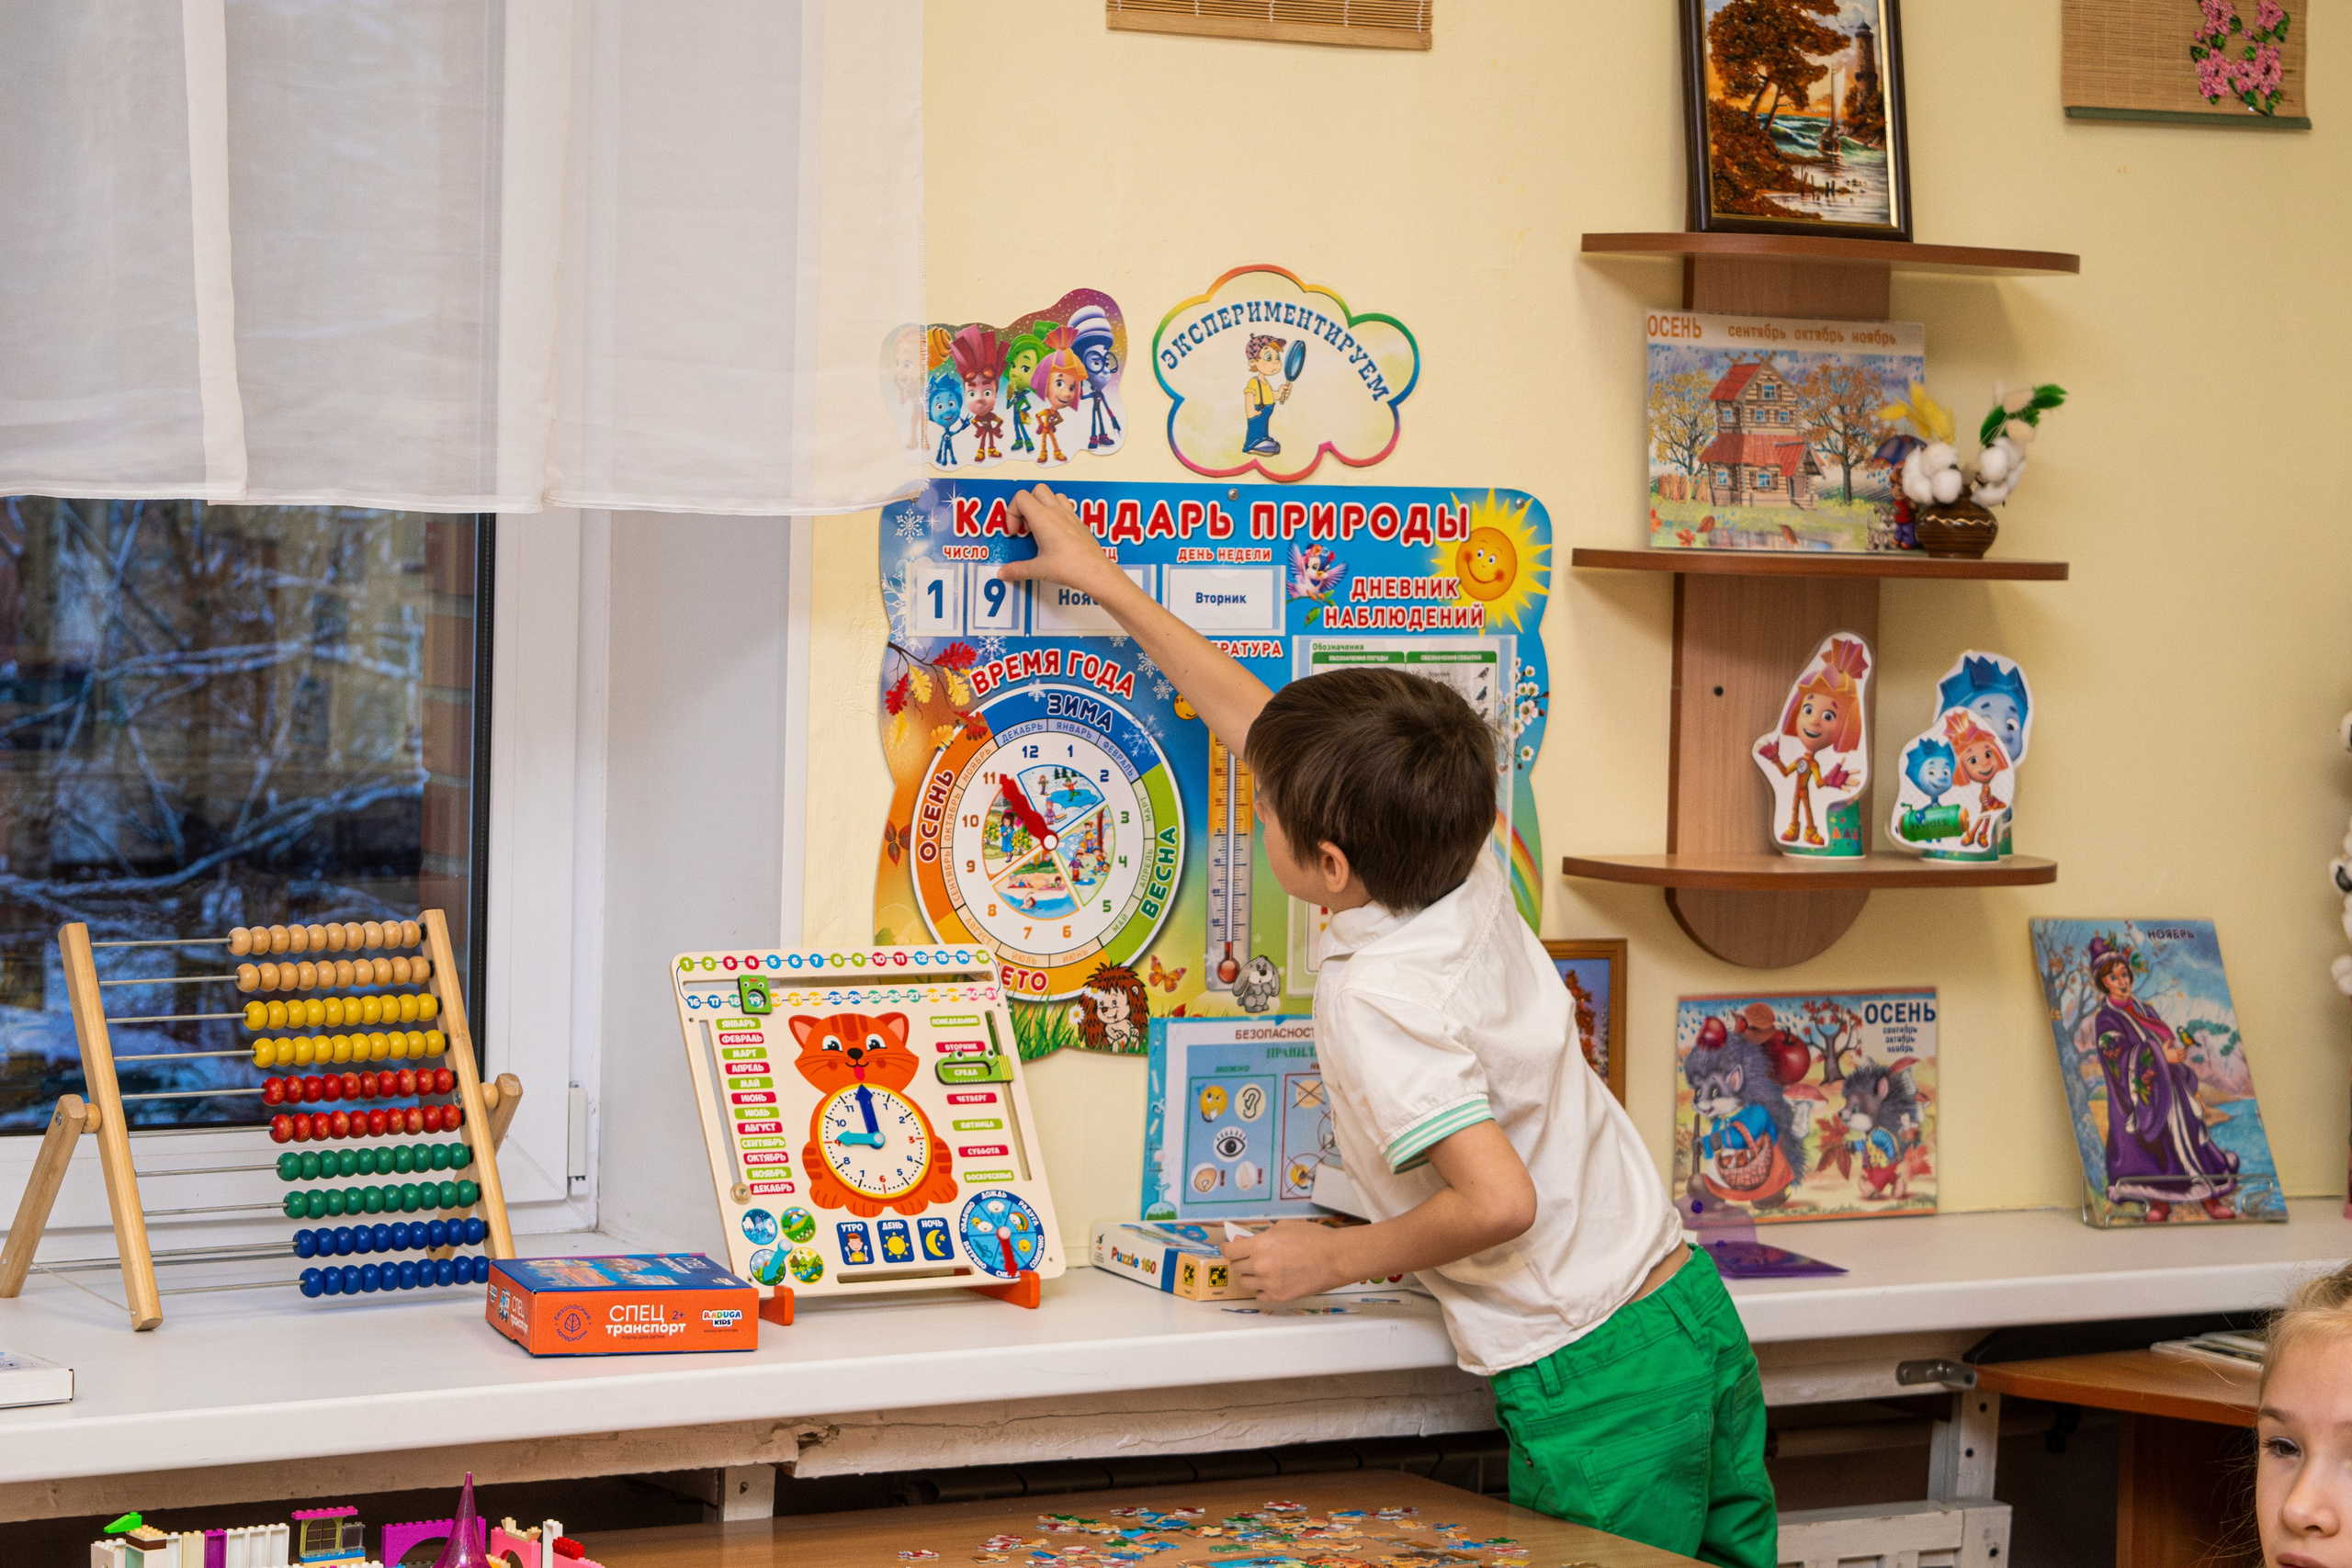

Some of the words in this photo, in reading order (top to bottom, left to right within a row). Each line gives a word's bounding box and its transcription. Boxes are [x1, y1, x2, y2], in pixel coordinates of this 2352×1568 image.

[1647, 314, 1702, 338] ОСЕНЬ
[1728, 323, 1786, 343] сентябрь
[1794, 326, 1844, 344] октябрь
[1851, 329, 1897, 347] ноябрь
[1160, 300, 1389, 401] ЭКСПЕРИМЕНТИРУЕМ
[954, 497, 1233, 545] КАНДАРЬ
[1251, 502, 1470, 547] ПРИРОДЫ
[944, 546, 989, 560] ЧИСЛО
[1178, 547, 1214, 563] ДЕНЬ
[1217, 548, 1272, 563] НЕДЕЛИ
[1351, 578, 1459, 602] ДНЕВНИК
[927, 580, 944, 618] 1
[984, 578, 1006, 618] 9
[1195, 592, 1247, 605] Вторник
[1324, 604, 1485, 631] НАБЛЮДЕНИЙ
[1312, 643, 1364, 651] Обозначения
[971, 649, 1059, 696] ВРЕМЯ
[1068, 649, 1136, 700] ГОДА
[1047, 694, 1114, 732] ЗИМА
[1001, 722, 1043, 743] ДЕКАБРЬ
[1057, 722, 1091, 739] ЯНВАРЬ
[1022, 745, 1039, 758] 12
[1067, 744, 1073, 758] 1
[962, 747, 991, 782] НОЯБРЬ
[1102, 740, 1134, 777] ФЕВРАЛЬ
[983, 772, 995, 784] 11
[1100, 769, 1109, 782] 2
[1139, 795, 1151, 822] МАРТ
[919, 769, 955, 862] ОСЕНЬ
[944, 793, 960, 840] ОКТЯБРЬ
[962, 815, 979, 828] 10
[1121, 810, 1129, 824] 3
[967, 860, 975, 873] 9
[1118, 855, 1127, 868] 4
[1139, 848, 1153, 888] АПРЕЛЬ
[944, 851, 960, 901] СЕНТЯБРЬ
[1140, 827, 1176, 919] ВЕСНА
[988, 904, 997, 917] 8
[1102, 900, 1111, 912] 5
[1112, 913, 1128, 933] МАЙ
[964, 917, 993, 945] АВГУСТ
[1023, 927, 1033, 940] 7
[1062, 925, 1071, 938] 6
[2147, 929, 2194, 939] НОЯБРЬ
[684, 960, 690, 968] 1
[706, 960, 713, 968] 2
[727, 959, 734, 967] 3
[748, 958, 755, 966] 4
[791, 957, 798, 965] 6
[834, 956, 842, 964] 8
[854, 956, 862, 964] 9
[874, 955, 885, 964] 10
[895, 954, 905, 963] 11
[957, 953, 968, 961] 14
[1011, 952, 1037, 964] ИЮЛЬ
[1062, 950, 1089, 963] ИЮНЬ
[998, 961, 1047, 991] ЕТО
[1865, 1002, 1936, 1024] ОСЕНЬ
[721, 1019, 755, 1028] ЯНВАРЬ
[721, 1034, 763, 1043] ФЕВРАЛЬ
[733, 1049, 756, 1057] МАРТ
[944, 1043, 978, 1051] ВТОРНИК
[731, 1064, 764, 1073] АПРЕЛЬ
[1215, 1065, 1250, 1073] МОЖНО
[741, 1078, 760, 1088] МАЙ
[741, 1093, 767, 1102] ИЮНЬ
[956, 1094, 987, 1102] ЧЕТВЕРГ
[744, 1109, 770, 1117] ИЮЛЬ
[744, 1123, 775, 1132] АВГУСТ
[741, 1139, 785, 1147] СЕНТЯБРЬ
[746, 1154, 786, 1162] ОКТЯБРЬ
[967, 1147, 1000, 1156] СУББОТА
[752, 1168, 786, 1178] НОЯБРЬ
[879, 1175, 886, 1183] 6
[752, 1183, 793, 1193] ДЕКАБРЬ
[981, 1190, 1007, 1200] ДОЖДЬ
[1018, 1200, 1039, 1226] РАДУГА
[841, 1224, 864, 1232] УТРО
[882, 1221, 903, 1230] ДЕНЬ
[921, 1219, 944, 1228] НОЧЬ
[1111, 1246, 1139, 1269] Puzzle
[609, 1304, 664, 1323] СПЕЦ
[672, 1310, 684, 1320] 2+
[704, 1310, 741, 1319] RADUGA
[605, 1323, 686, 1337] транспорт
